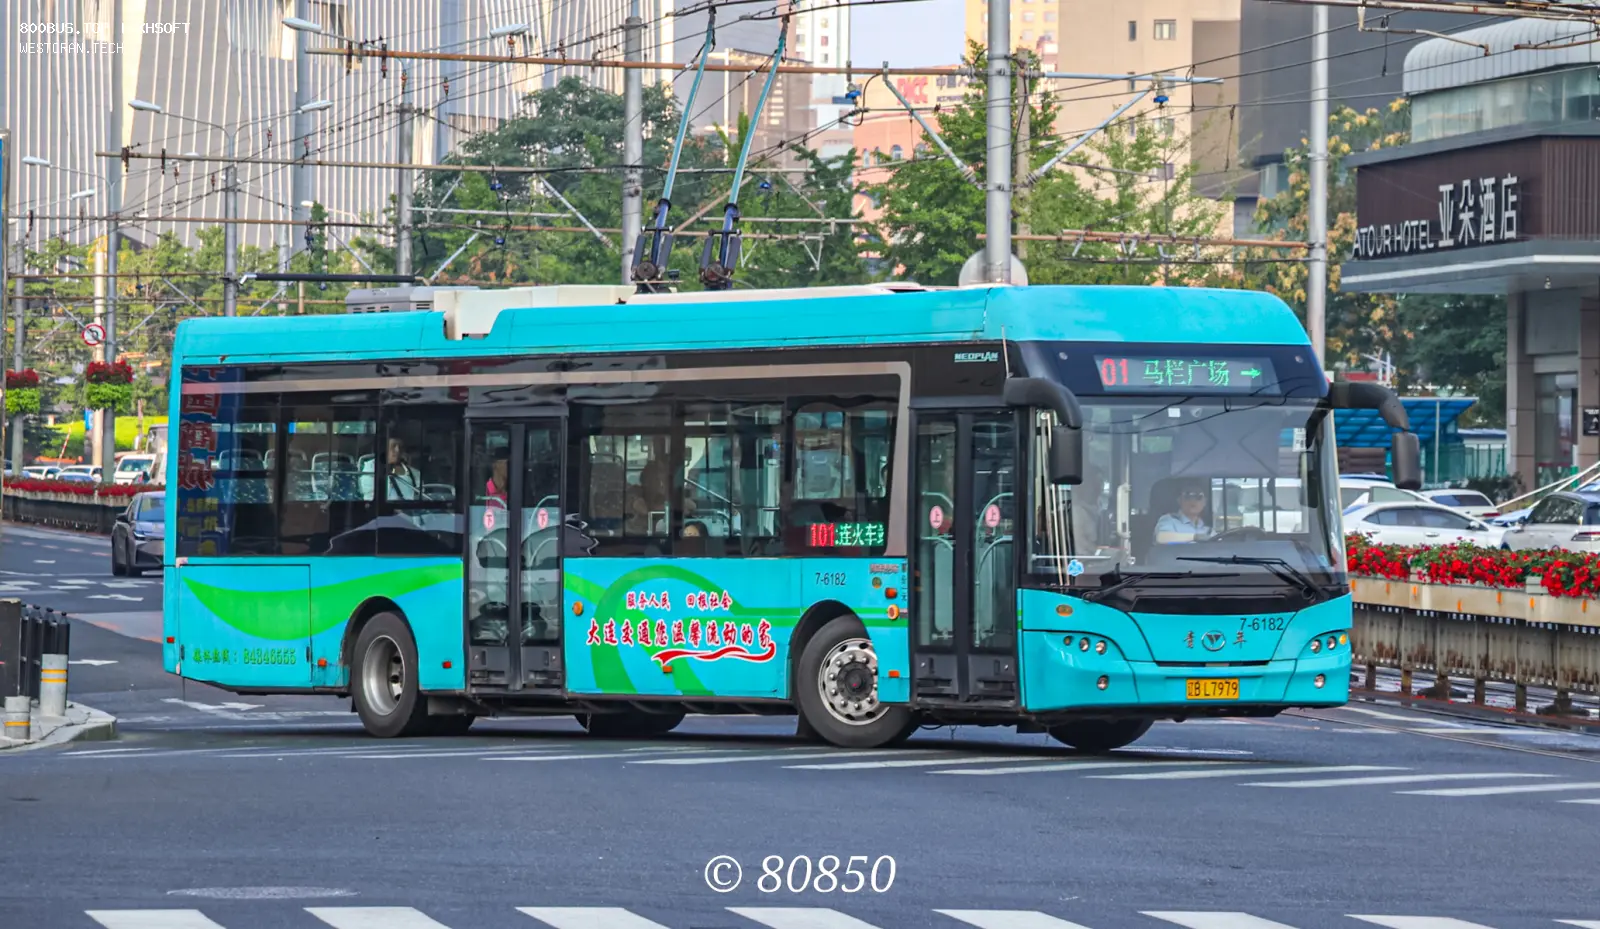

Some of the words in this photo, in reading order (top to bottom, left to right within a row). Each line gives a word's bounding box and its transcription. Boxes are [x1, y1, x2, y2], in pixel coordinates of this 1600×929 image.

[1438, 172, 1518, 248] 亚朵酒店
[1352, 224, 1392, 258] ATOUR
[1393, 219, 1435, 253] HOTEL
[1142, 359, 1230, 386] 马栏广场
[810, 523, 835, 547] 101
[815, 571, 847, 586] 7-6182
[625, 591, 671, 612] 服务人民
[685, 589, 733, 612] 回报社会
[1240, 617, 1284, 631] 7-6182
